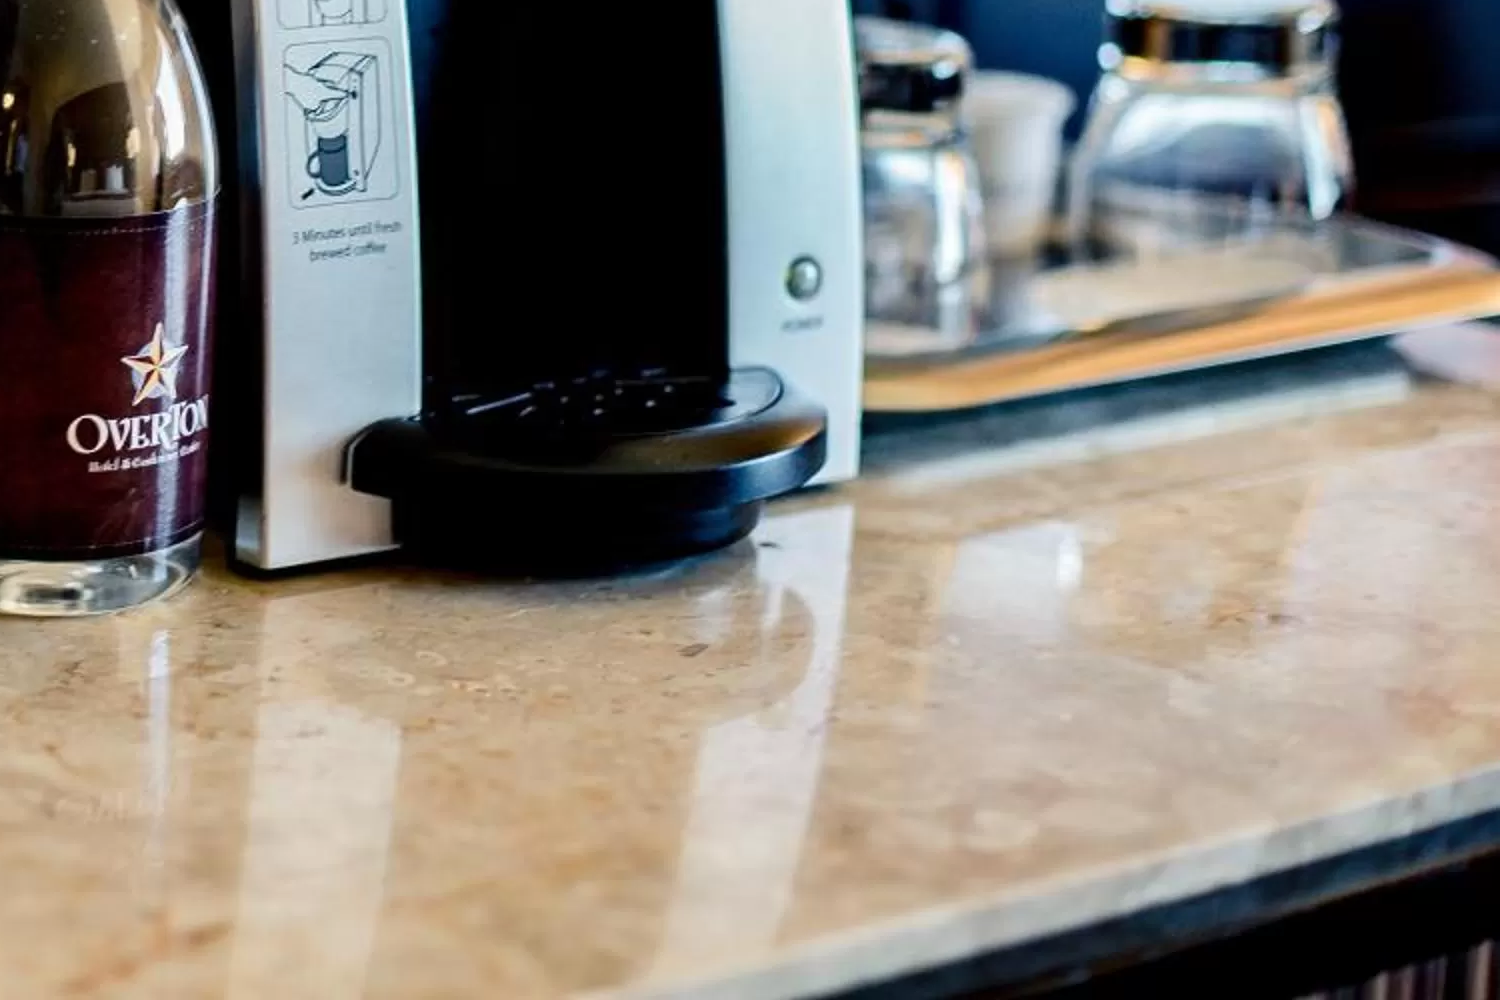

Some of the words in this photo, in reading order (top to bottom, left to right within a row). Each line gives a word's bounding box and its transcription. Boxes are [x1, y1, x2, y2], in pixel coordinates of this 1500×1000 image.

[302, 228, 346, 242] Minutes
[348, 221, 373, 237] until
[309, 245, 352, 262] brewed
[354, 242, 388, 257] coffee
